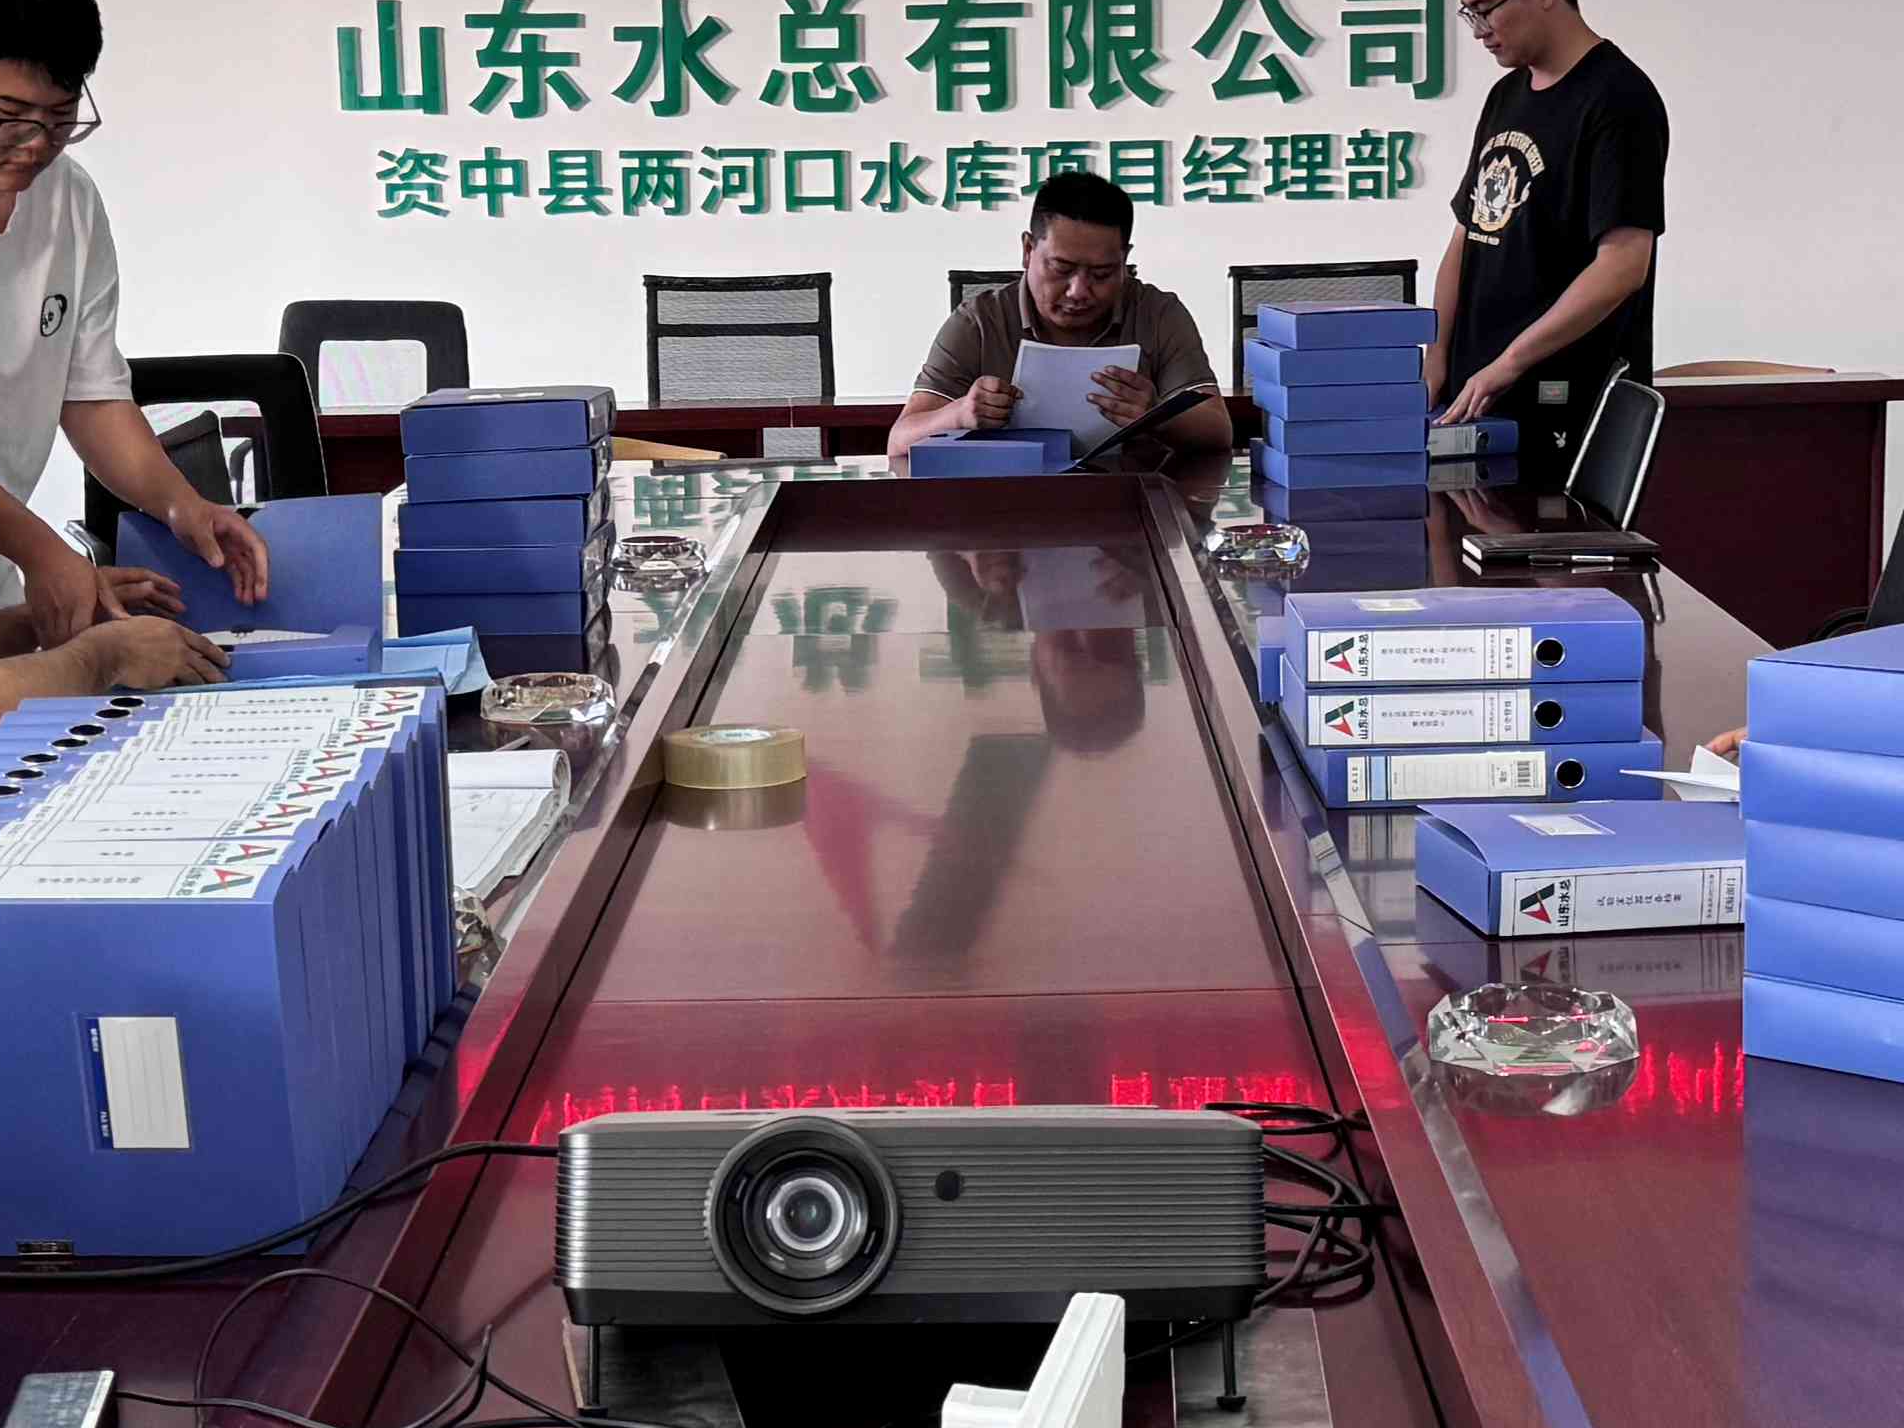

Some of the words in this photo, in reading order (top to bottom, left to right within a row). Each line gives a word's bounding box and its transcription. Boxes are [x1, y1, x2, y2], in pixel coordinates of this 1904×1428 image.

[376, 130, 1422, 220] 资中县两河口水库项目经理部
[1358, 633, 1369, 677] 山东水总
[1358, 697, 1369, 740] 山东水总
[1557, 879, 1571, 928] 山东水总
